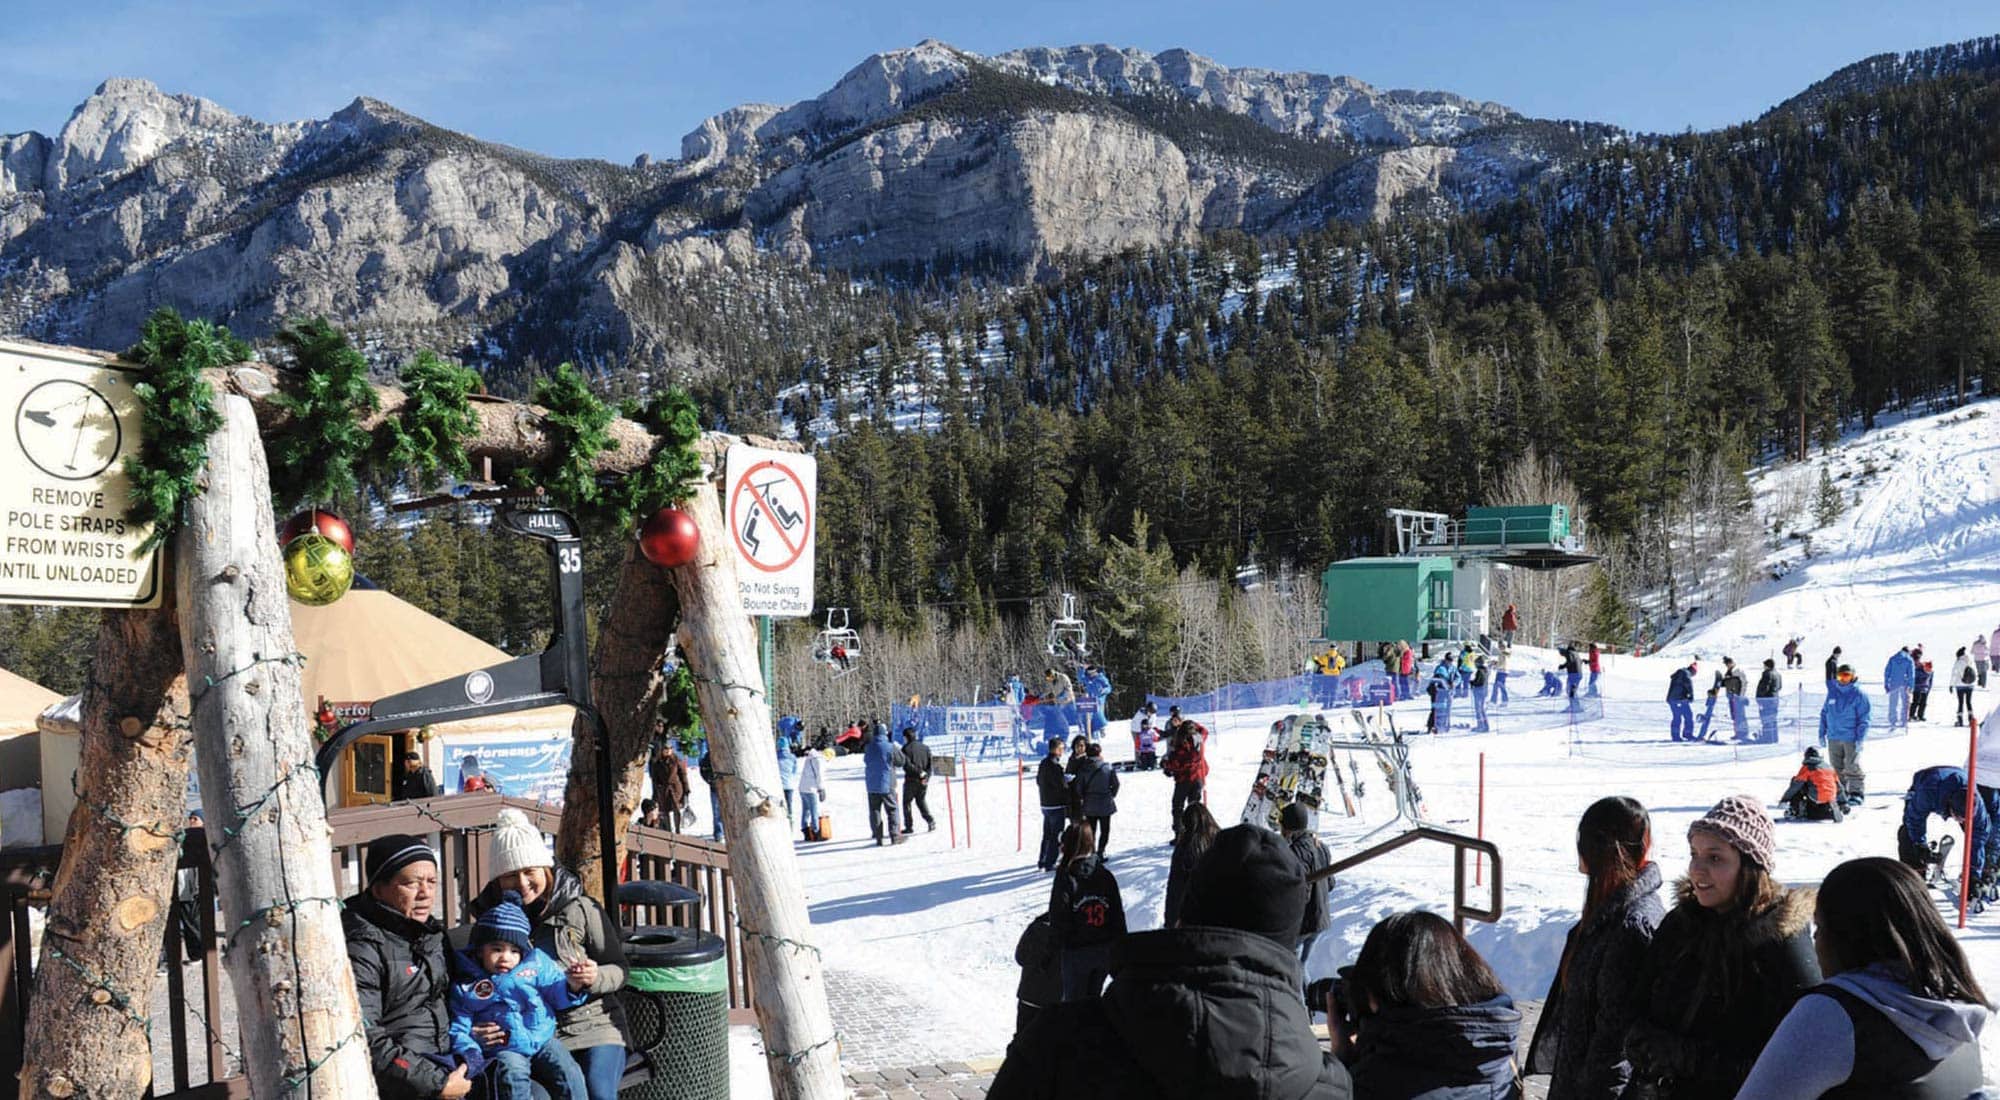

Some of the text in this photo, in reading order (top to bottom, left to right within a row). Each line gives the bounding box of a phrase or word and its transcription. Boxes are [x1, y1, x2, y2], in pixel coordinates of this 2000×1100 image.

[32, 487, 104, 509] REMOVE
[8, 511, 125, 535] POLE STRAPS
[528, 514, 560, 528] HALL
[7, 536, 124, 559] FROM WRISTS
[559, 547, 582, 573] 35
[0, 563, 137, 585] NTIL UNLOADED
[738, 582, 800, 598] Do Not Swing
[743, 598, 808, 610] Bounce Chairs
[1084, 904, 1105, 927] 13
